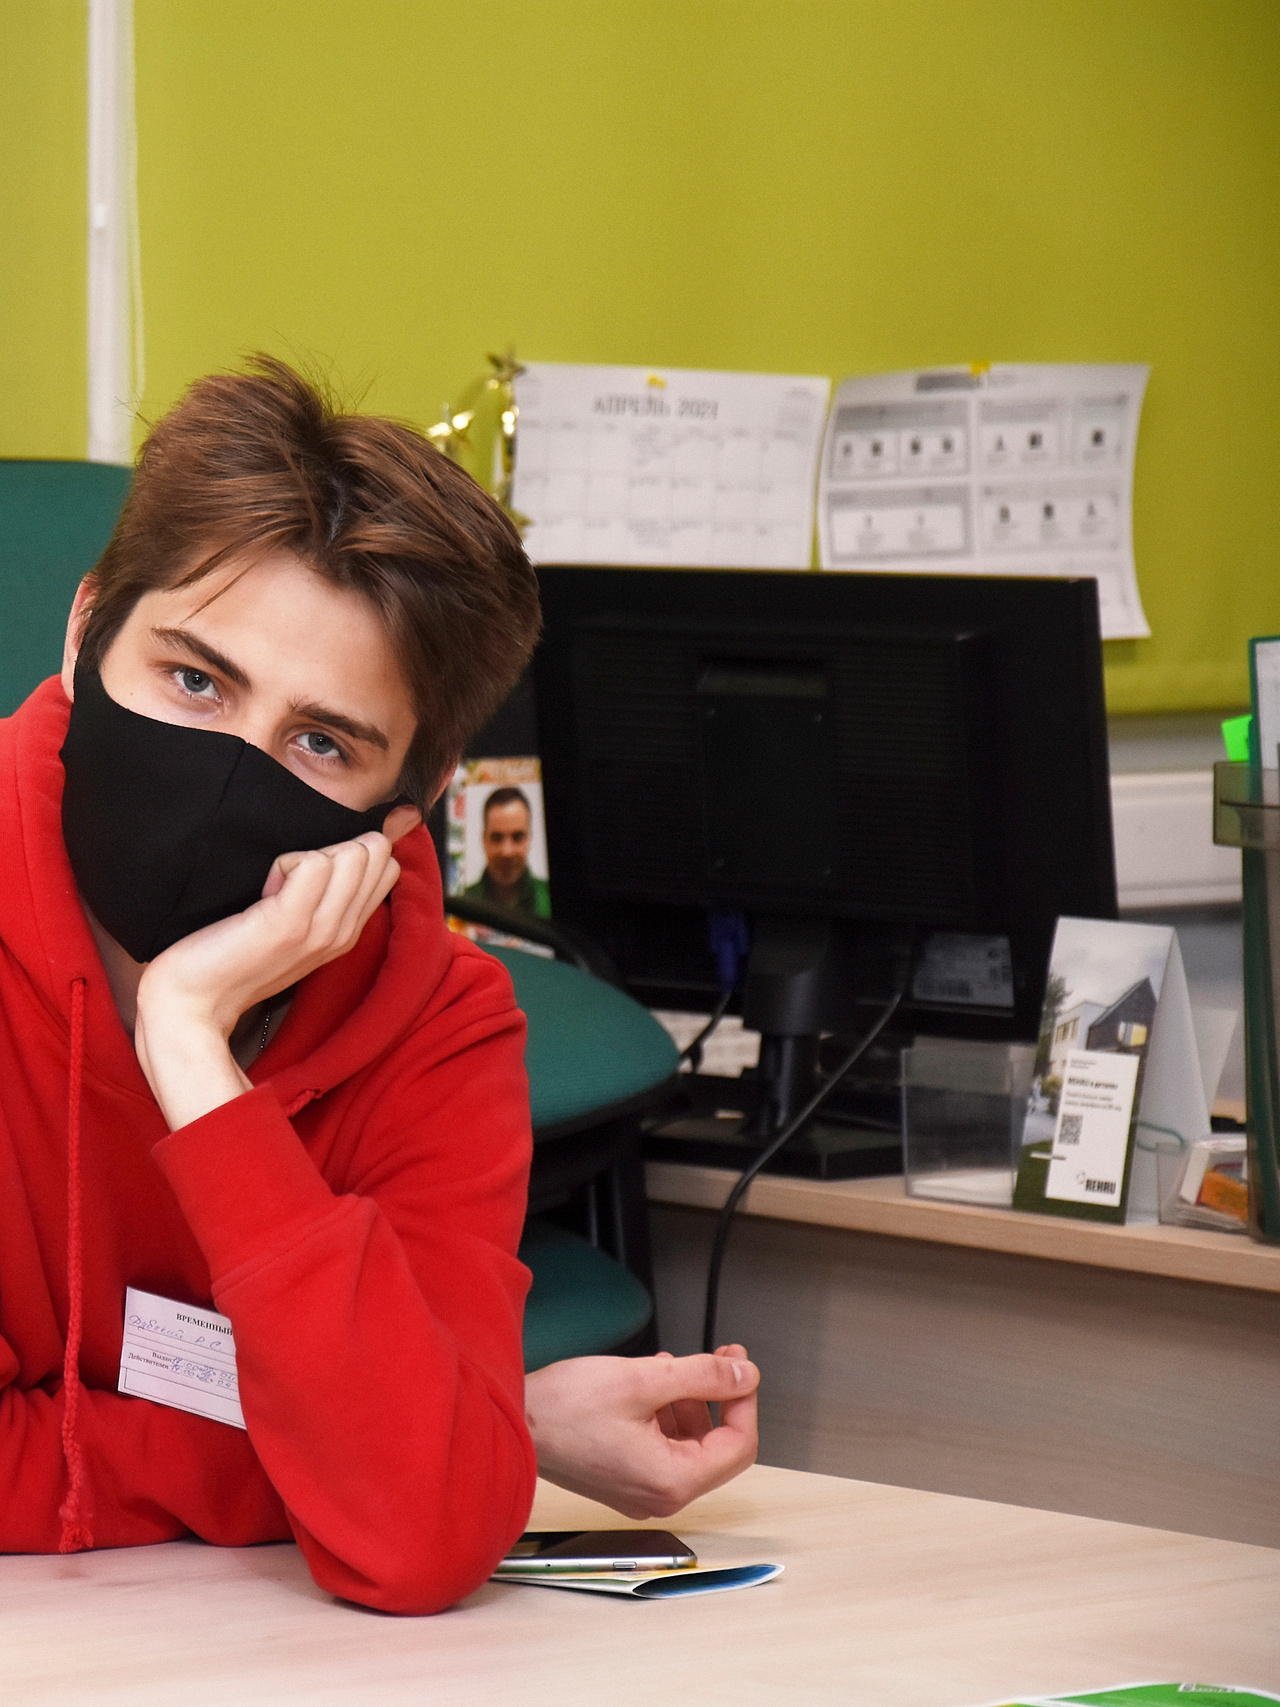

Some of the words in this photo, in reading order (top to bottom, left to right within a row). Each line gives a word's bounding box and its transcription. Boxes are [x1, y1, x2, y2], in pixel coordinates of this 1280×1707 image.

[677, 397, 719, 420] 2021
[1085, 1179, 1116, 1195] REHAU
[176, 1313, 232, 1336] ВРЕМЕННЫЙ
